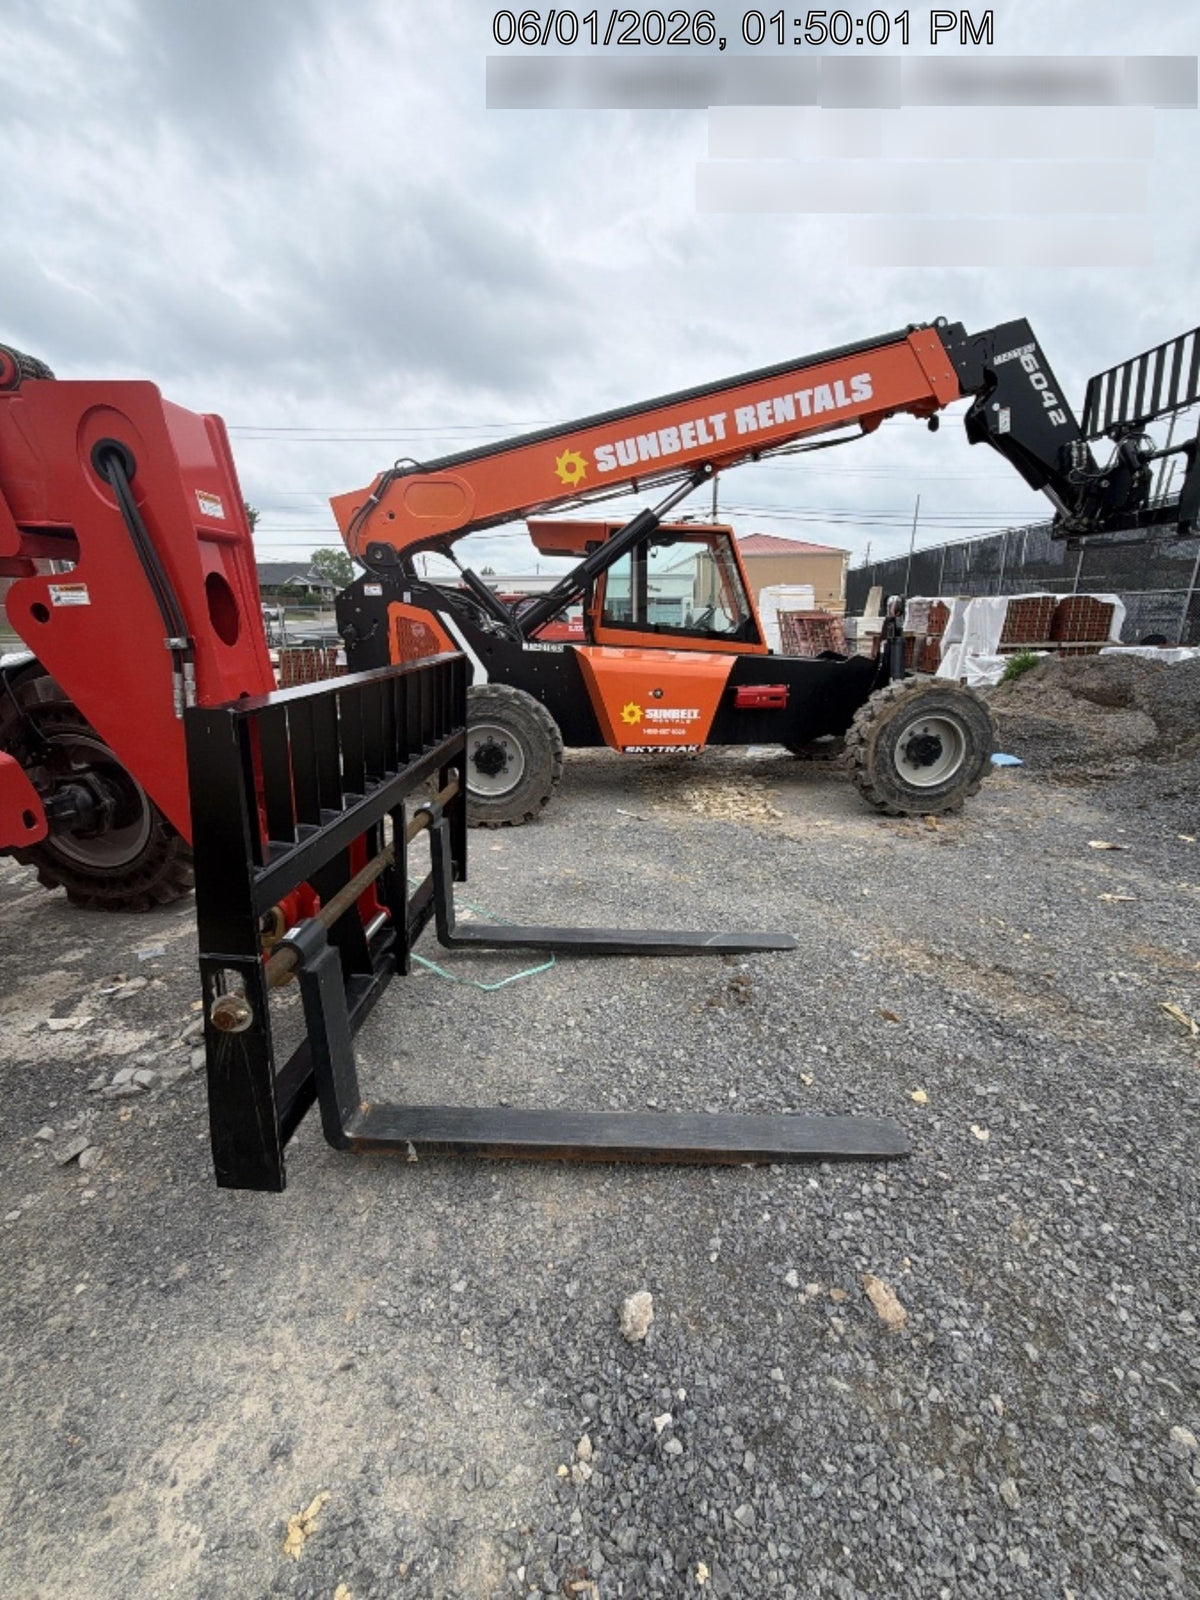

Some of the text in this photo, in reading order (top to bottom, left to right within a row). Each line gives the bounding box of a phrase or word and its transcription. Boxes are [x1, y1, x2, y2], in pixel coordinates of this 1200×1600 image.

[1020, 353, 1067, 427] 6042
[593, 373, 873, 472] SUNBELT RENTALS
[644, 708, 700, 719] SUNBELT
[624, 744, 699, 753] SKYTRAK
